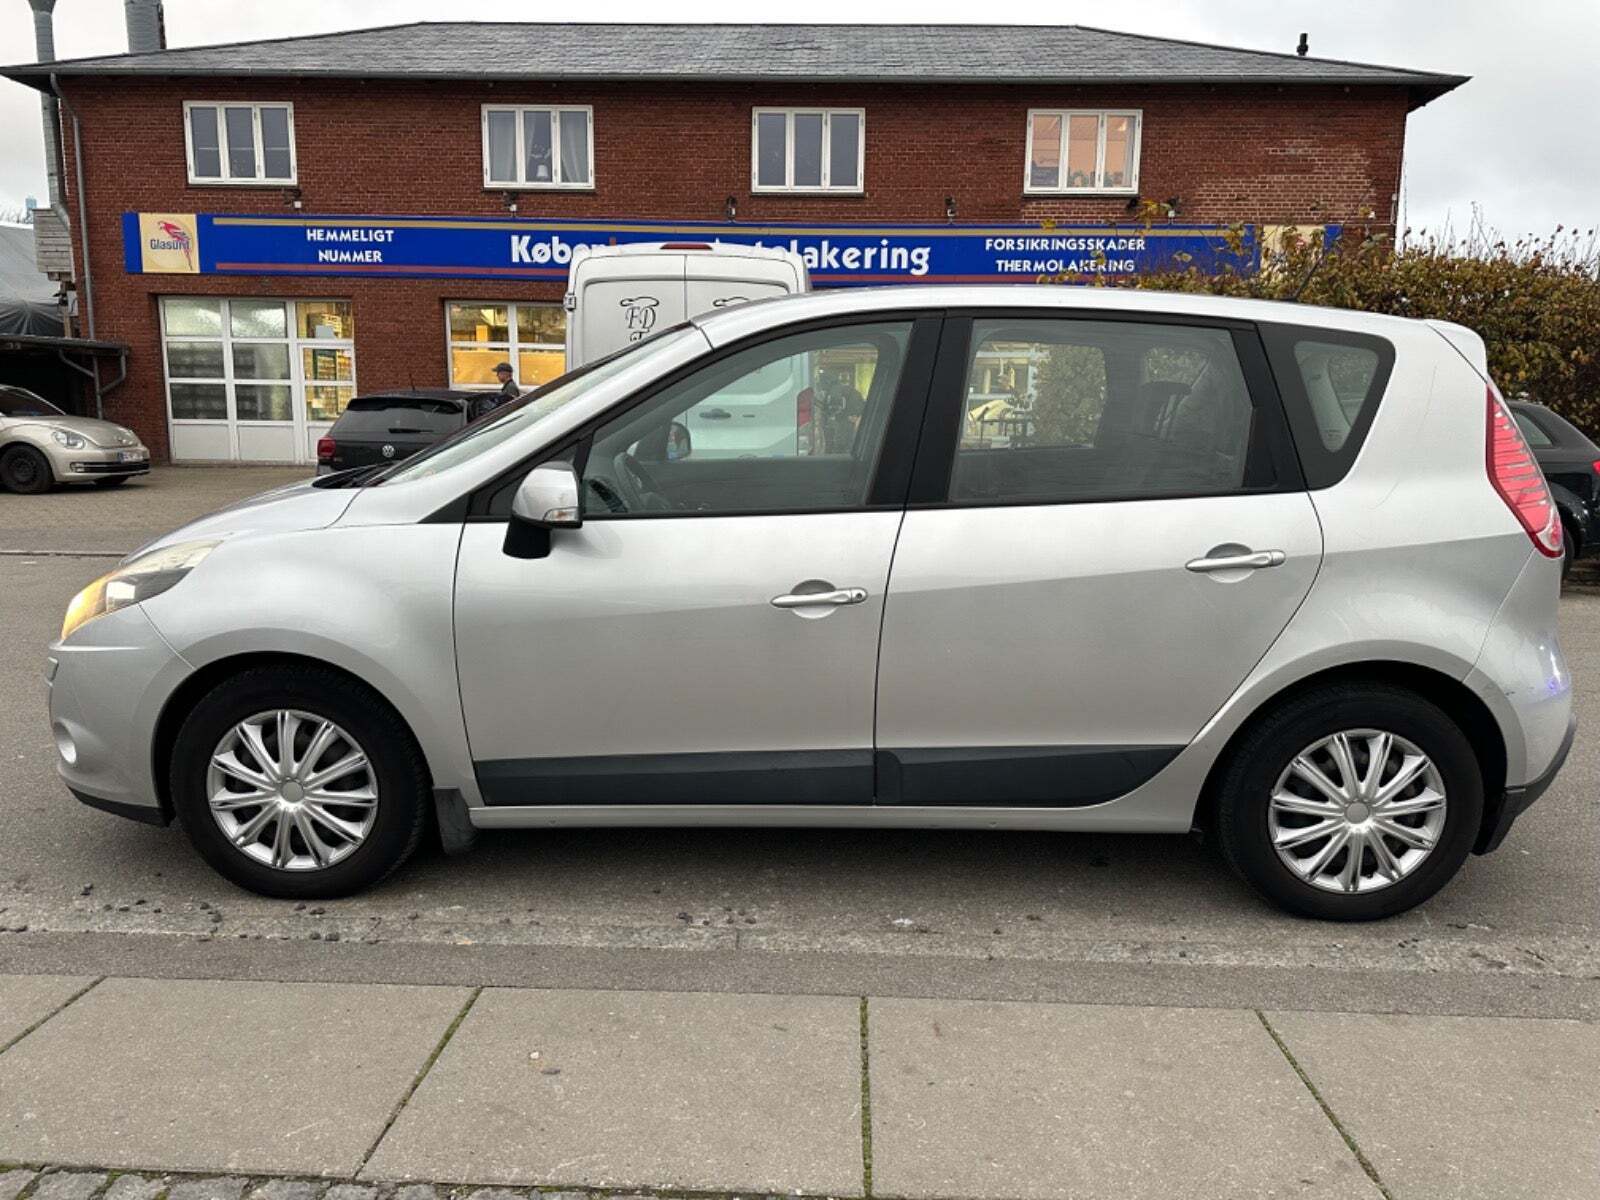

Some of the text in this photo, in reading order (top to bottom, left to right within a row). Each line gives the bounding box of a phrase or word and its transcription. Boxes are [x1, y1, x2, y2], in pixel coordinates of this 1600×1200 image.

[306, 228, 395, 243] HEMMELIGT
[985, 237, 1146, 252] FORSIKRINGSSKADER
[318, 249, 384, 264] NUMMER
